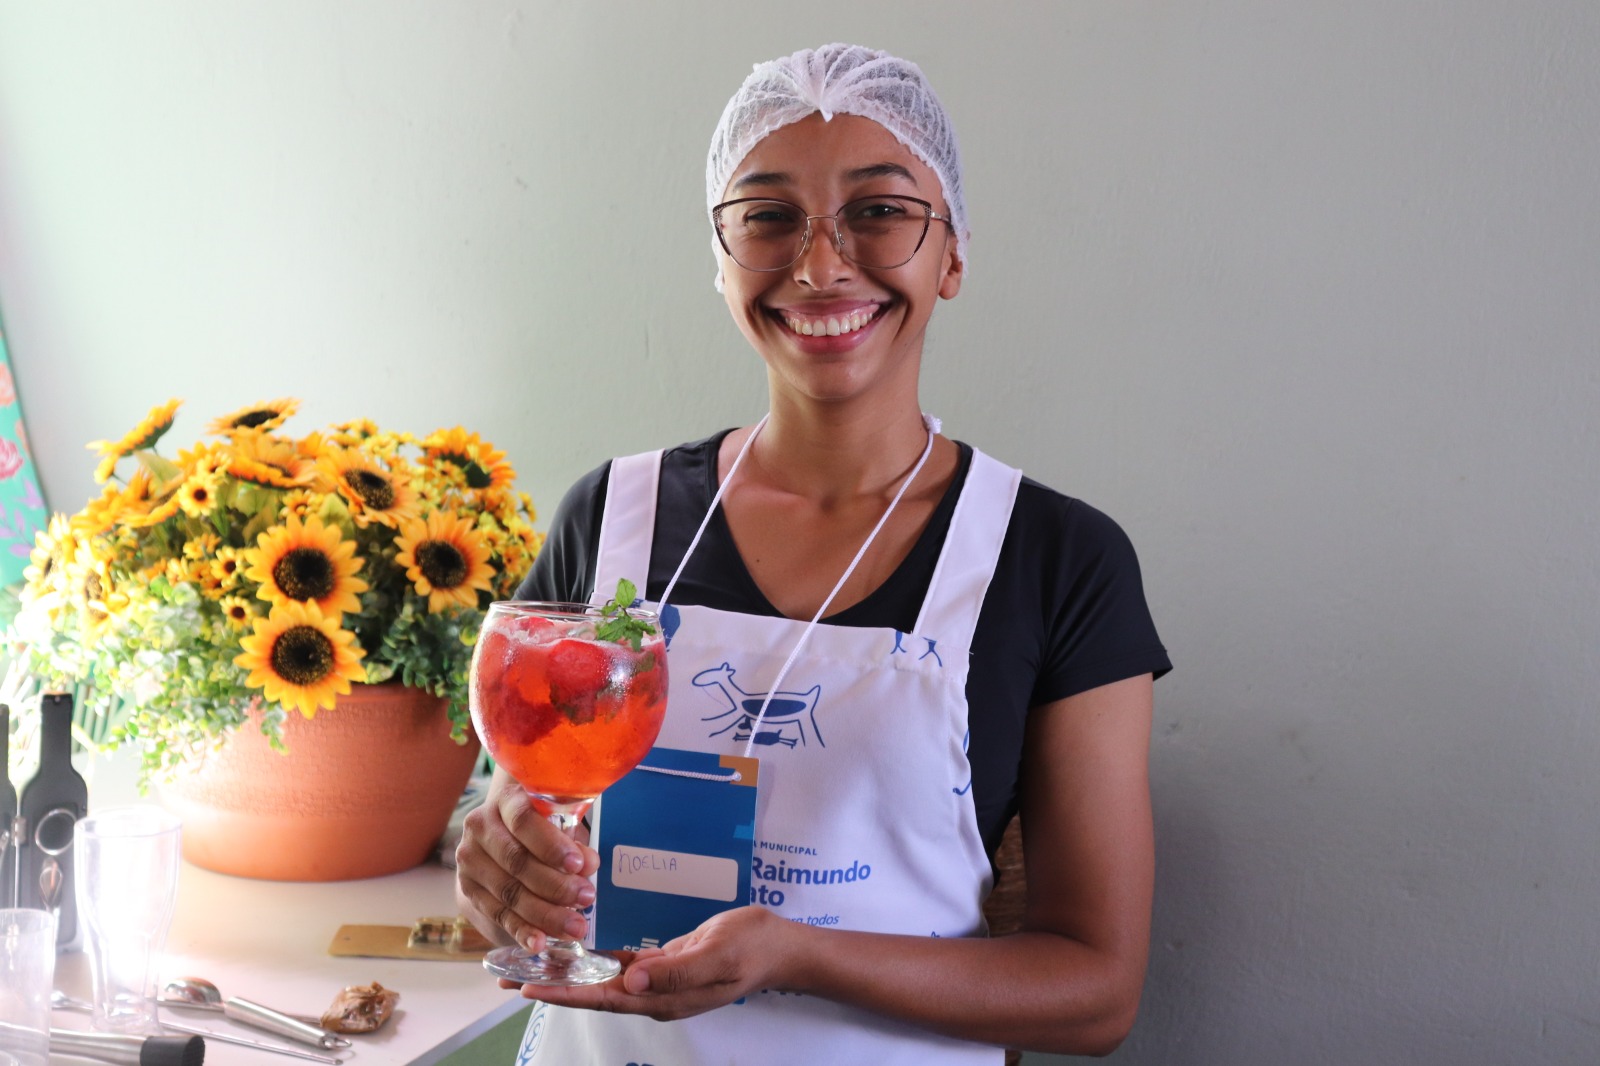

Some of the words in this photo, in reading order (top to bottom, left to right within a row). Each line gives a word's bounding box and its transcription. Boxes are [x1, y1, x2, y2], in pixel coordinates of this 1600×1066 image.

[760, 841, 818, 856] MUNICIPAL
[752, 857, 871, 885] Raimundo
[806, 914, 839, 926] todos
